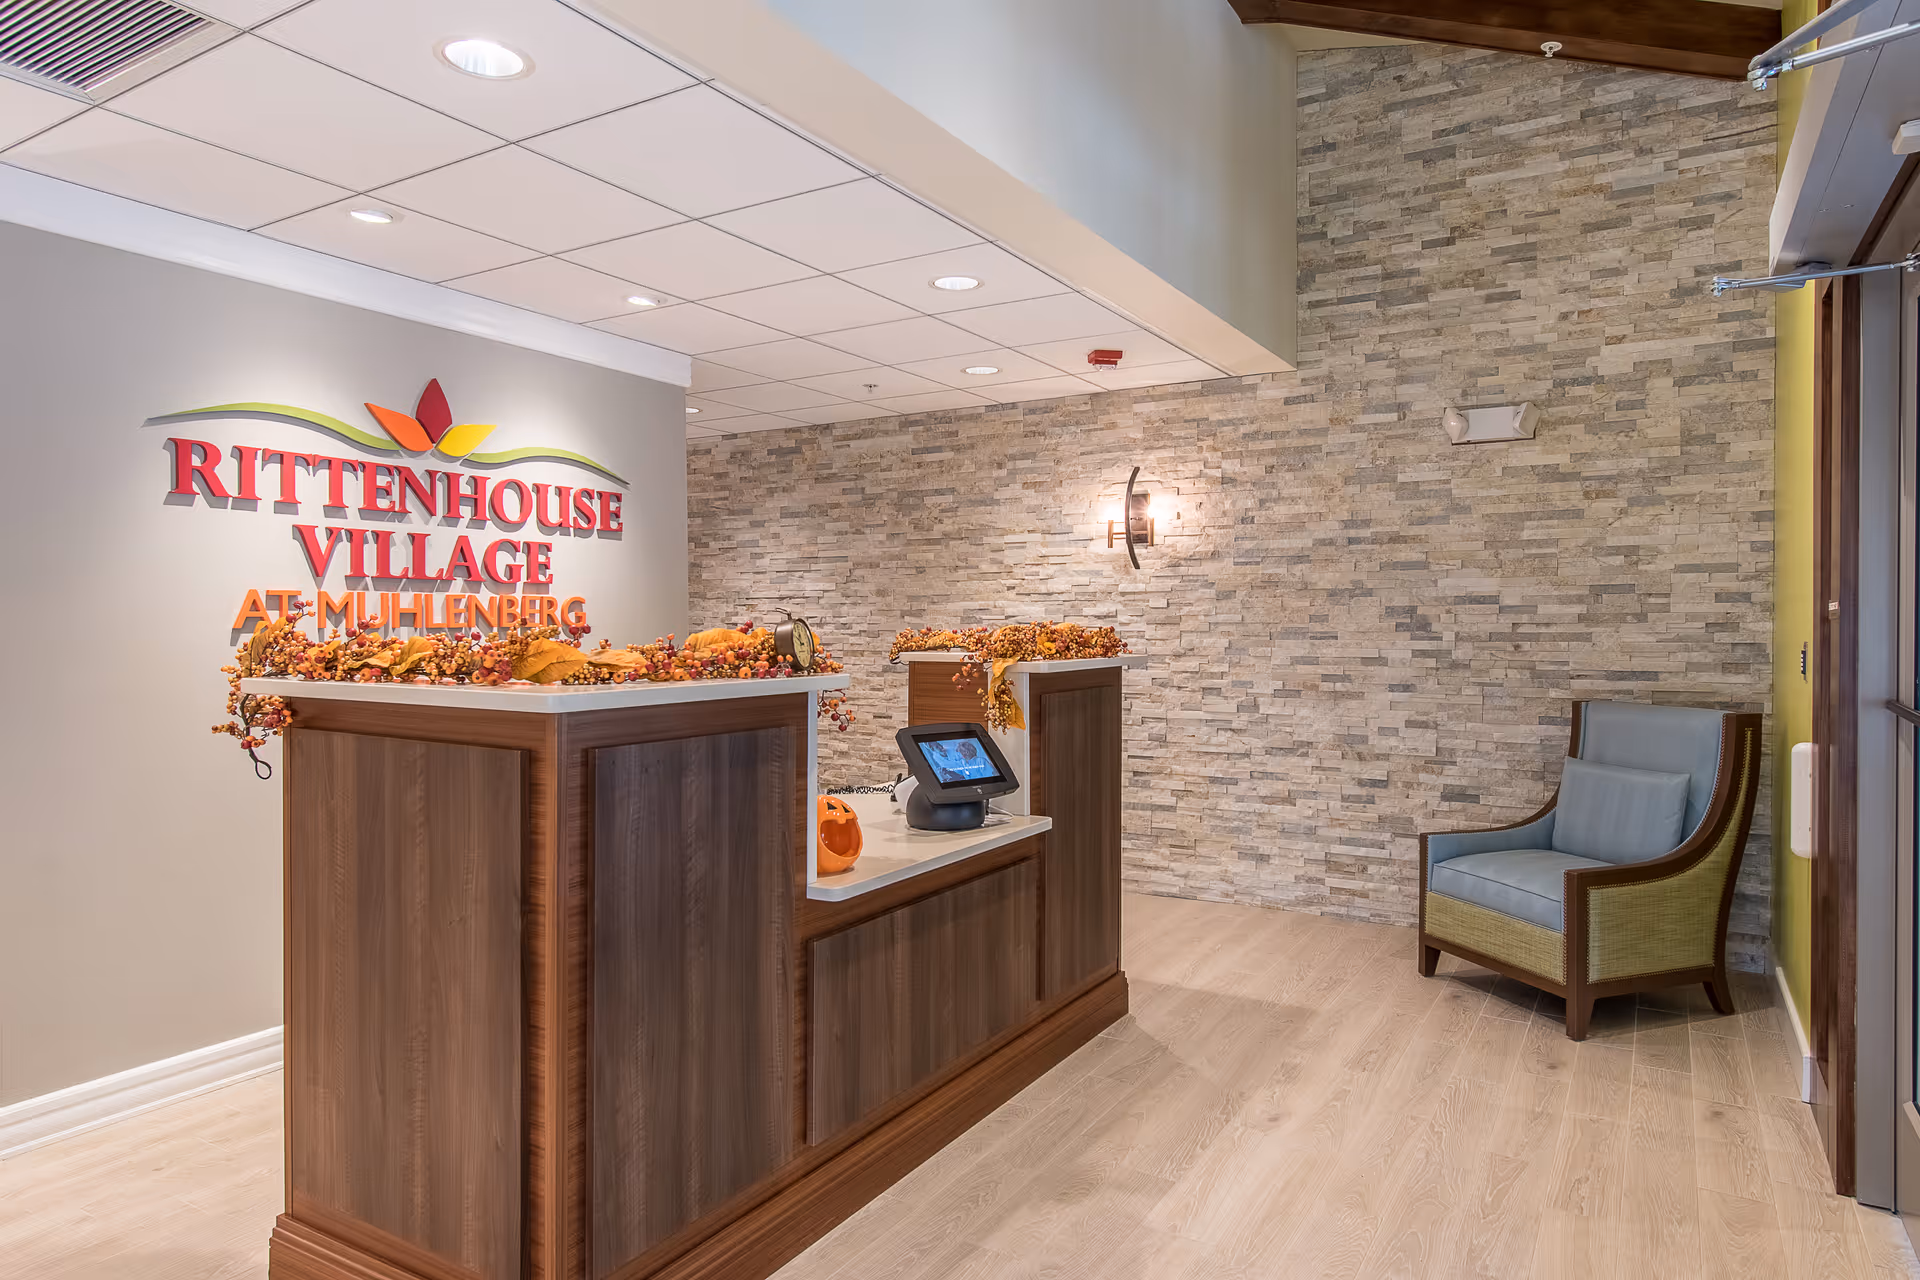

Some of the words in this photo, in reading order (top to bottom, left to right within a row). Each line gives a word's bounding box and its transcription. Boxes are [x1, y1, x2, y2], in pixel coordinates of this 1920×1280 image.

[168, 437, 623, 532] RITTENHOUSE
[292, 524, 553, 584] VILLAGE
[232, 589, 302, 630] AT
[317, 590, 587, 629] MUHLENBERG
